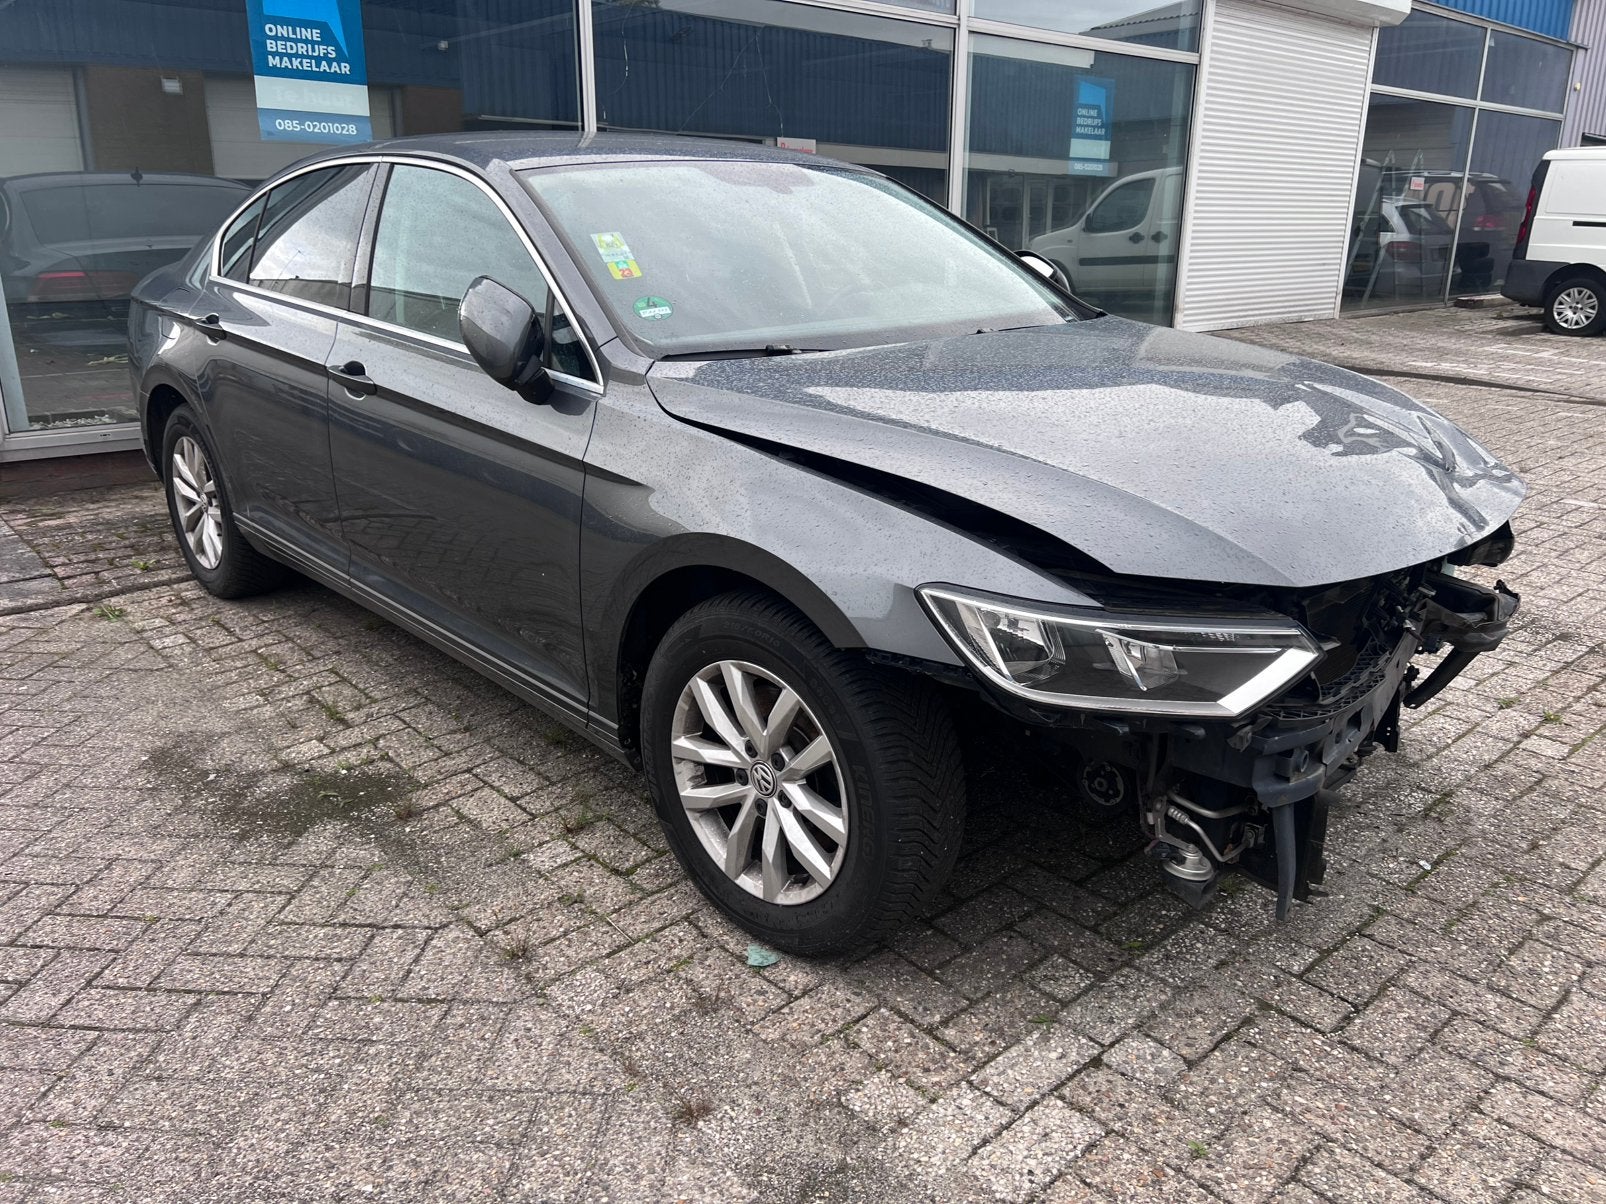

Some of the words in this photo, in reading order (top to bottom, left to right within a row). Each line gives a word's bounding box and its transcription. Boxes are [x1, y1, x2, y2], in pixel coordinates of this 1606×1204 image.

[264, 23, 322, 42] ONLINE
[266, 39, 337, 58] BEDRIJFS
[267, 55, 351, 75] MAKELAAR
[1077, 107, 1098, 117] ONLINE
[275, 119, 357, 135] 085-0201028
[1076, 117, 1102, 126] BEDRIJFS
[1075, 126, 1106, 136] MAKELAAR
